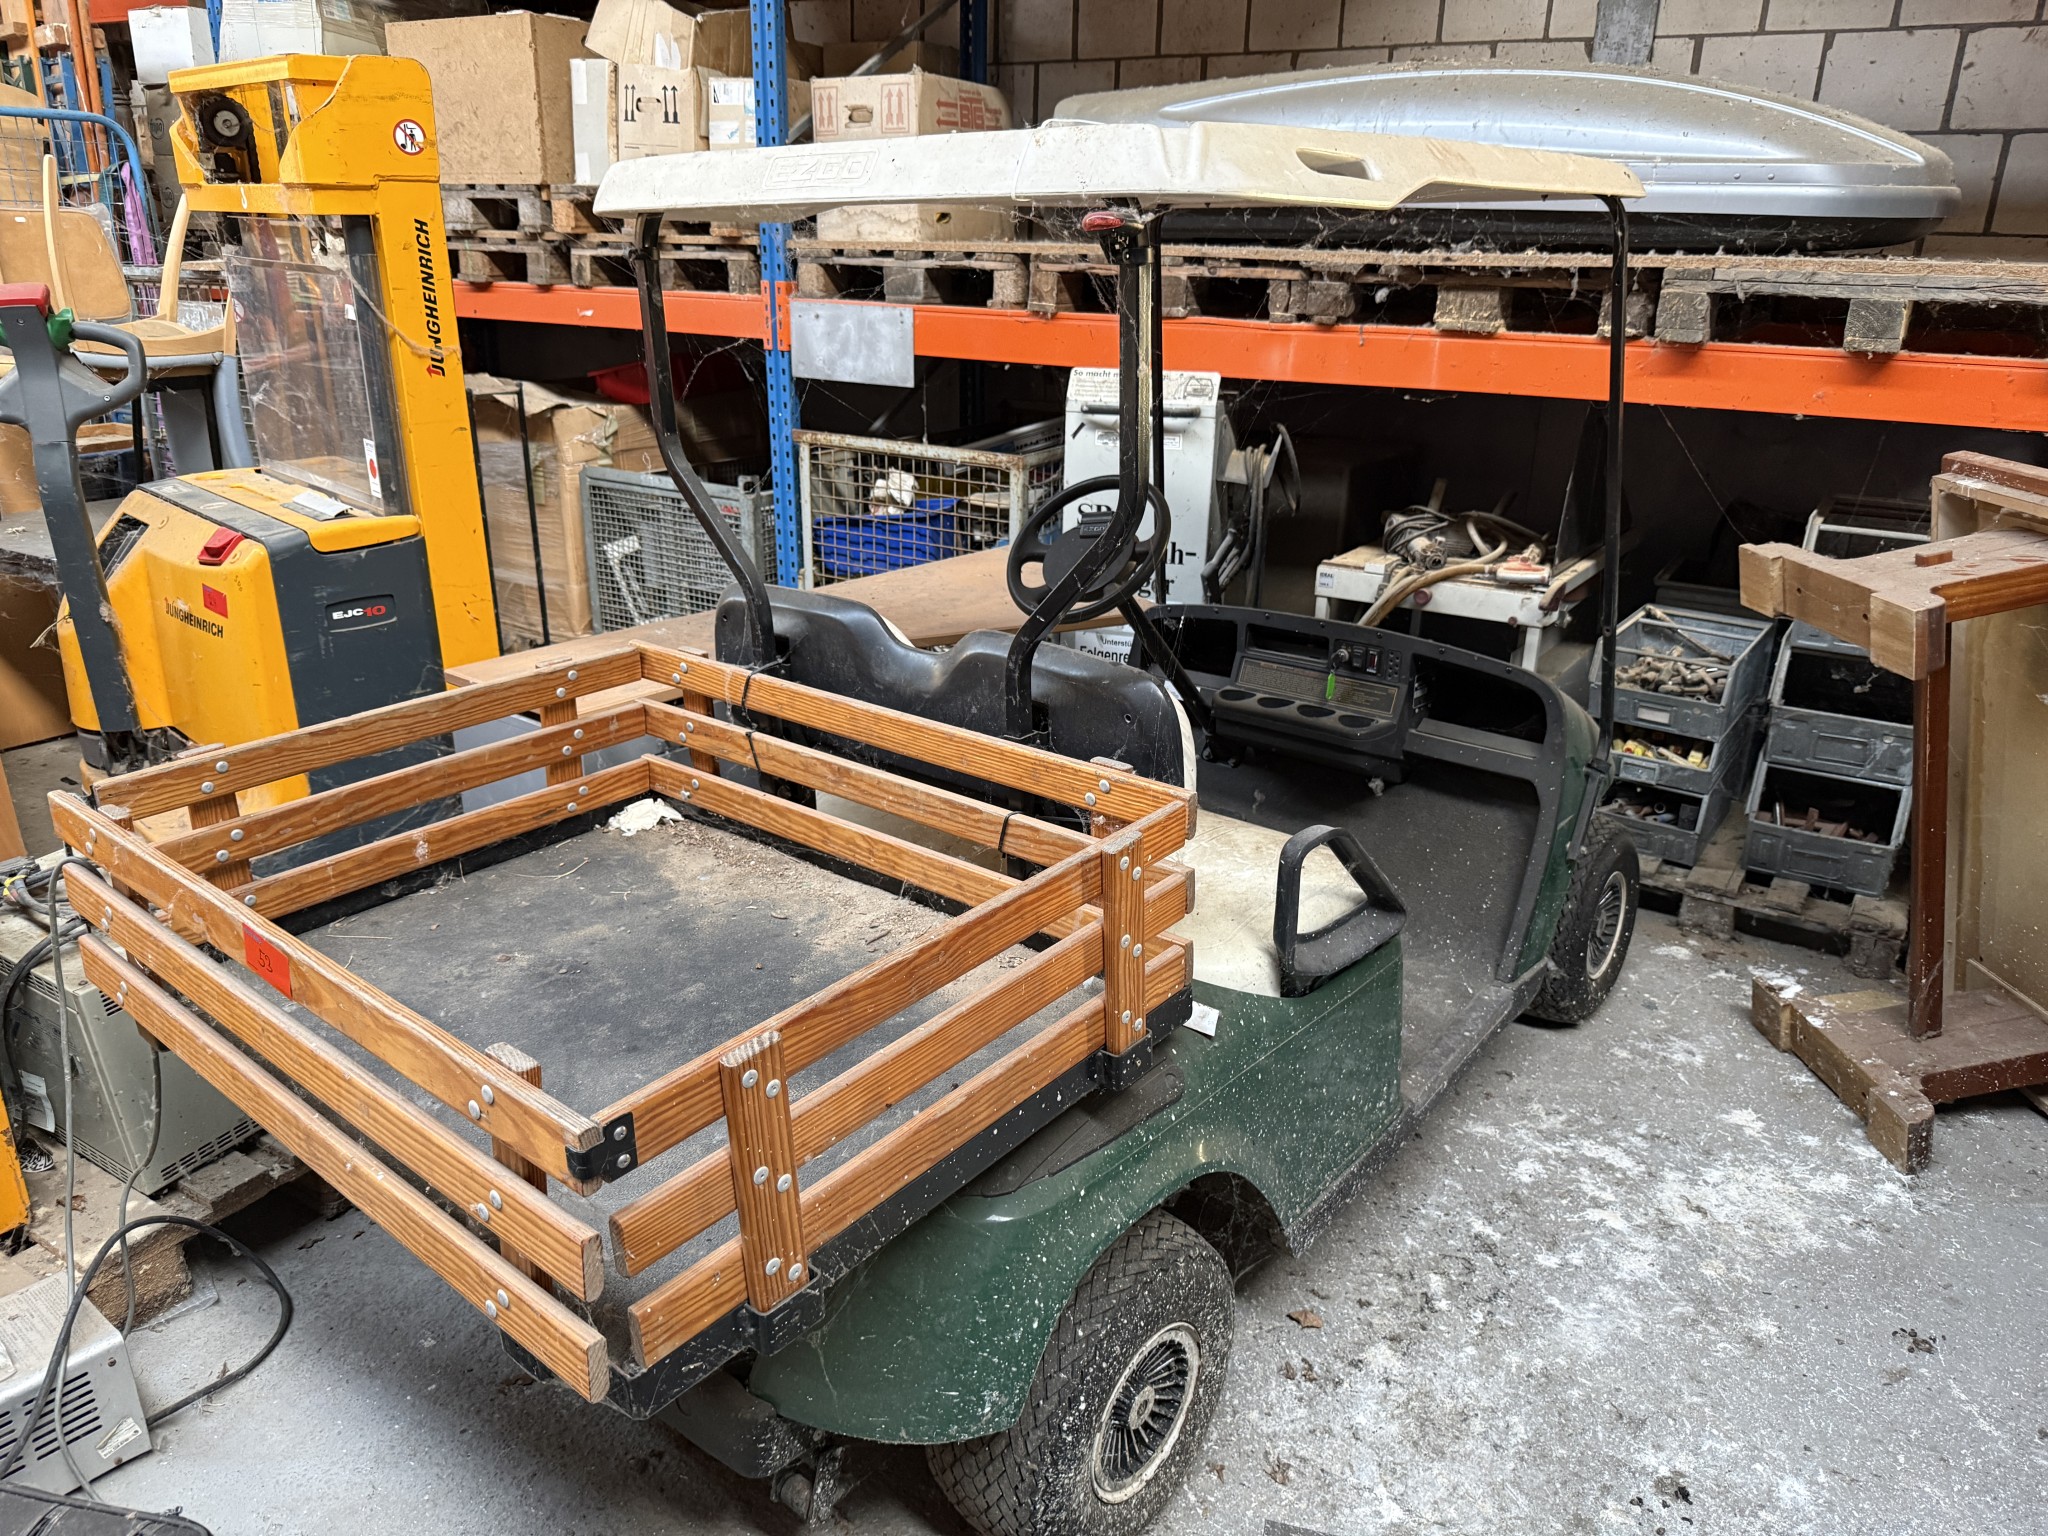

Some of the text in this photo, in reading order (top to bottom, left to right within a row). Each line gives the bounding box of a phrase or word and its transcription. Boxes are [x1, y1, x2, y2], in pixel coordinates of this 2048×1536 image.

[414, 218, 446, 378] JUNGHEINRICH
[1085, 369, 1111, 377] macht
[164, 596, 224, 638] JUNGHEINRICH
[257, 948, 273, 973] 53
